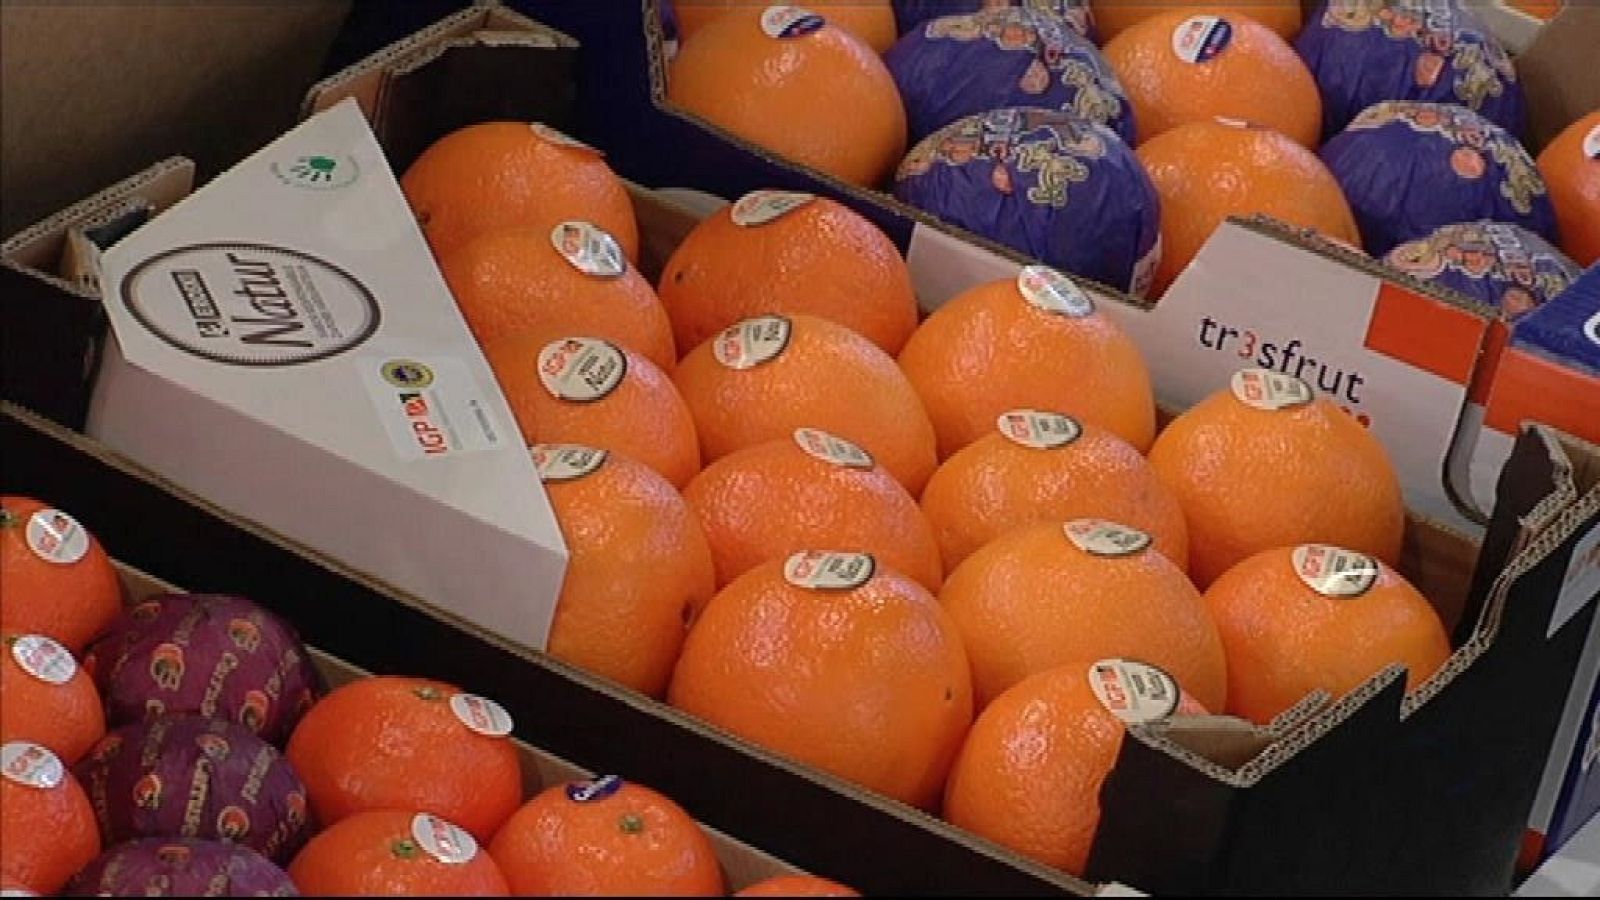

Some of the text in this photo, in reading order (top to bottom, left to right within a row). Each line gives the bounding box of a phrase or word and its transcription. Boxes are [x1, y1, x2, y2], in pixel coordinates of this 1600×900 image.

[225, 252, 314, 348] Natur
[1199, 315, 1365, 404] tr3sfrut
[412, 421, 449, 455] IGP
